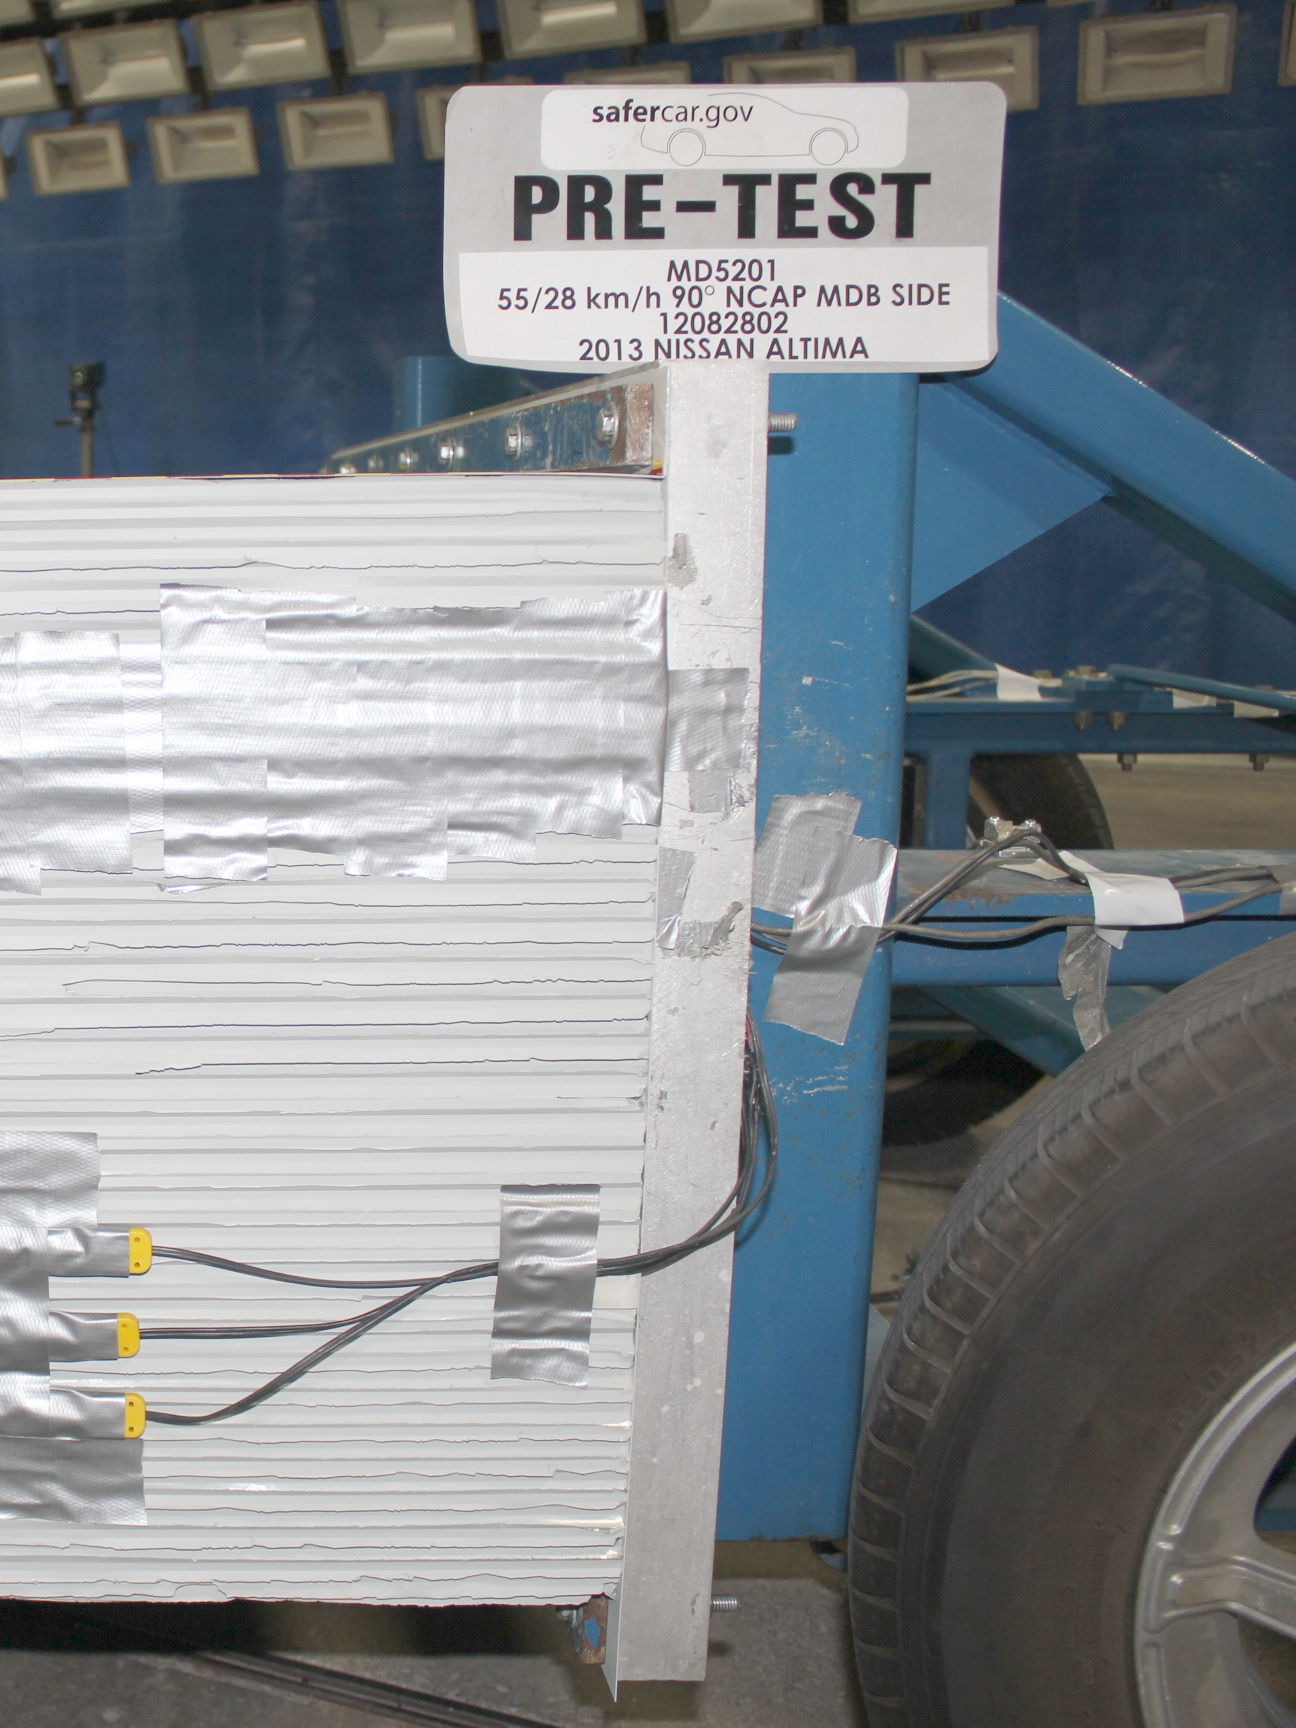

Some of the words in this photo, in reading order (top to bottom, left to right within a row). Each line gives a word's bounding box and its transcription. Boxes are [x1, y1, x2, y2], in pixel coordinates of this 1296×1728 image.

[591, 98, 754, 129] safercar.gov
[513, 171, 932, 242] PRE-TEST
[666, 258, 776, 283] MD5201
[497, 286, 577, 314] 55/28
[586, 285, 661, 313] km/h
[725, 284, 807, 309] NCAP
[816, 283, 882, 307] MDB
[891, 282, 951, 307] SIDE
[658, 310, 789, 335] 12082802
[578, 338, 644, 362] 2013
[653, 337, 755, 360] NISSAN
[765, 336, 870, 360] ALTIMA
